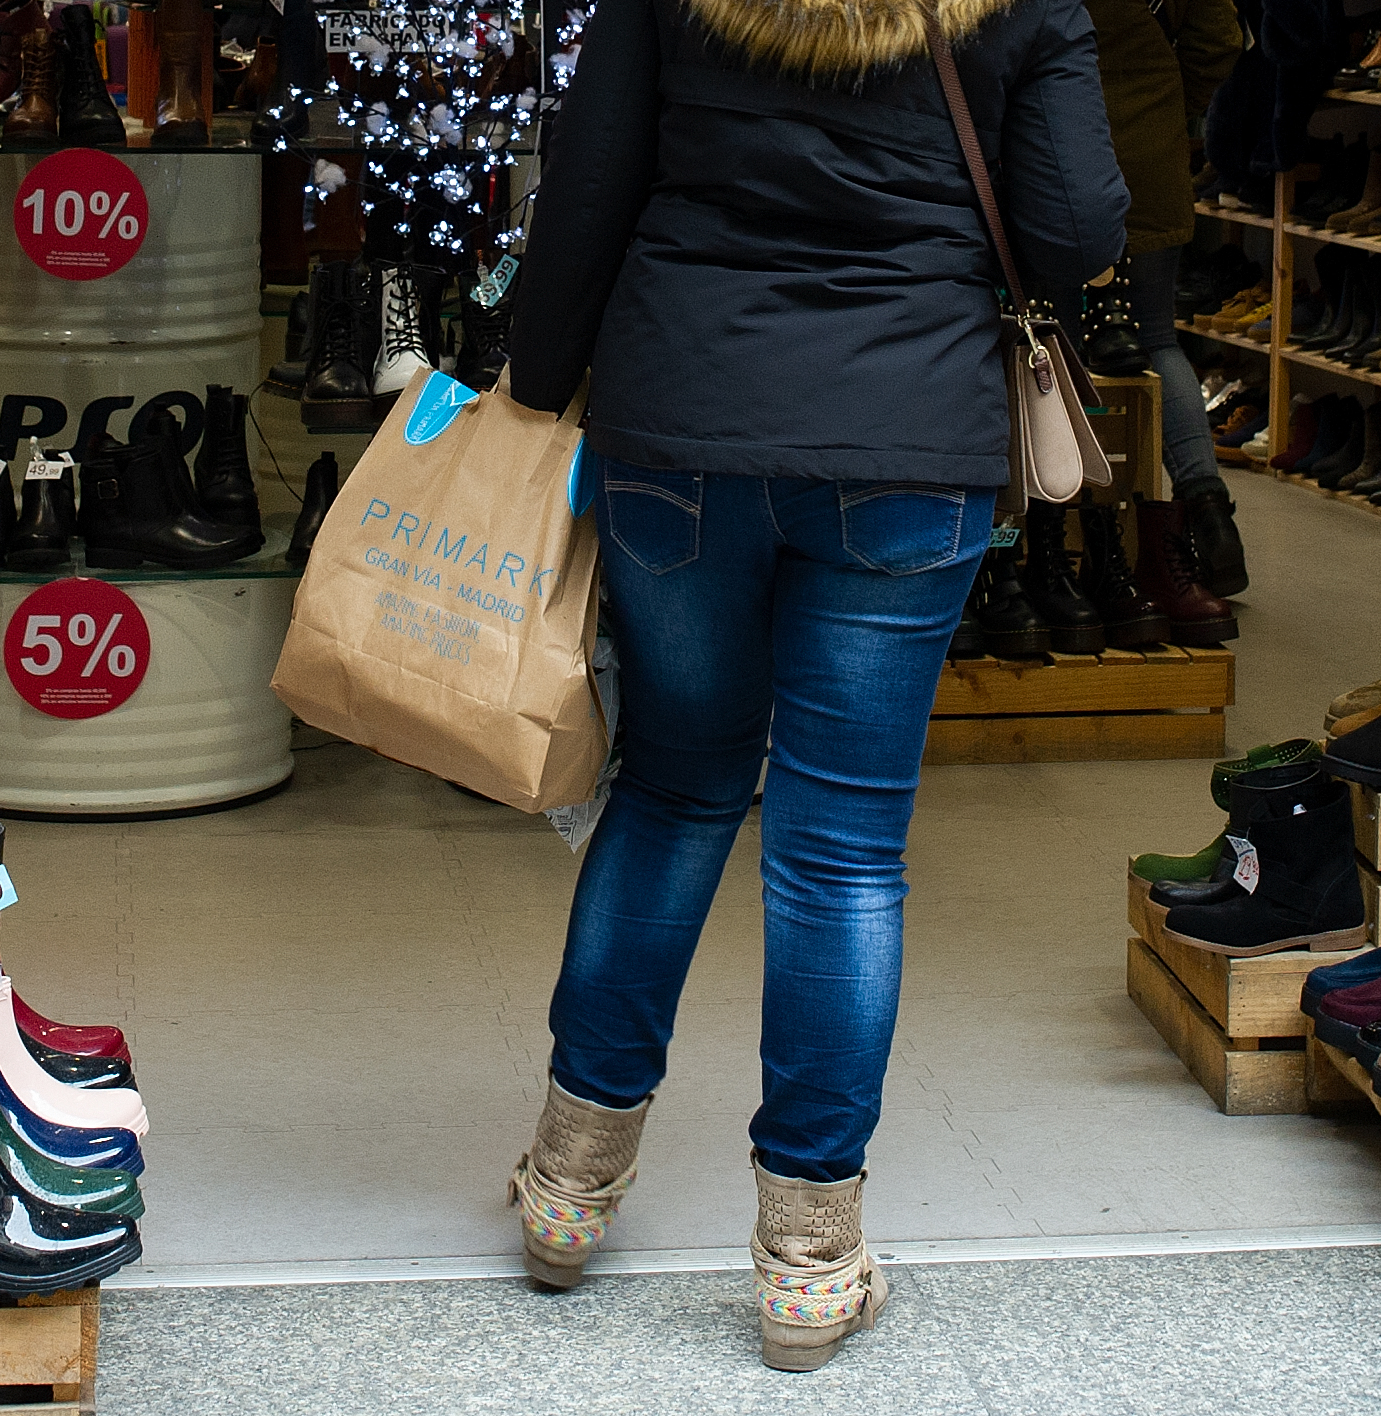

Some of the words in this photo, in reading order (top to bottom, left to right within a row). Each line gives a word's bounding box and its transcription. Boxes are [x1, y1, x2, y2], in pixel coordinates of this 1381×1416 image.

[330, 32, 356, 47] EN
[23, 189, 138, 239] 10%
[29, 464, 59, 476] 49,99
[360, 498, 554, 596] PRIMARK
[365, 547, 408, 577] GRAN
[457, 584, 525, 622] MADRID
[21, 614, 135, 677] 5%
